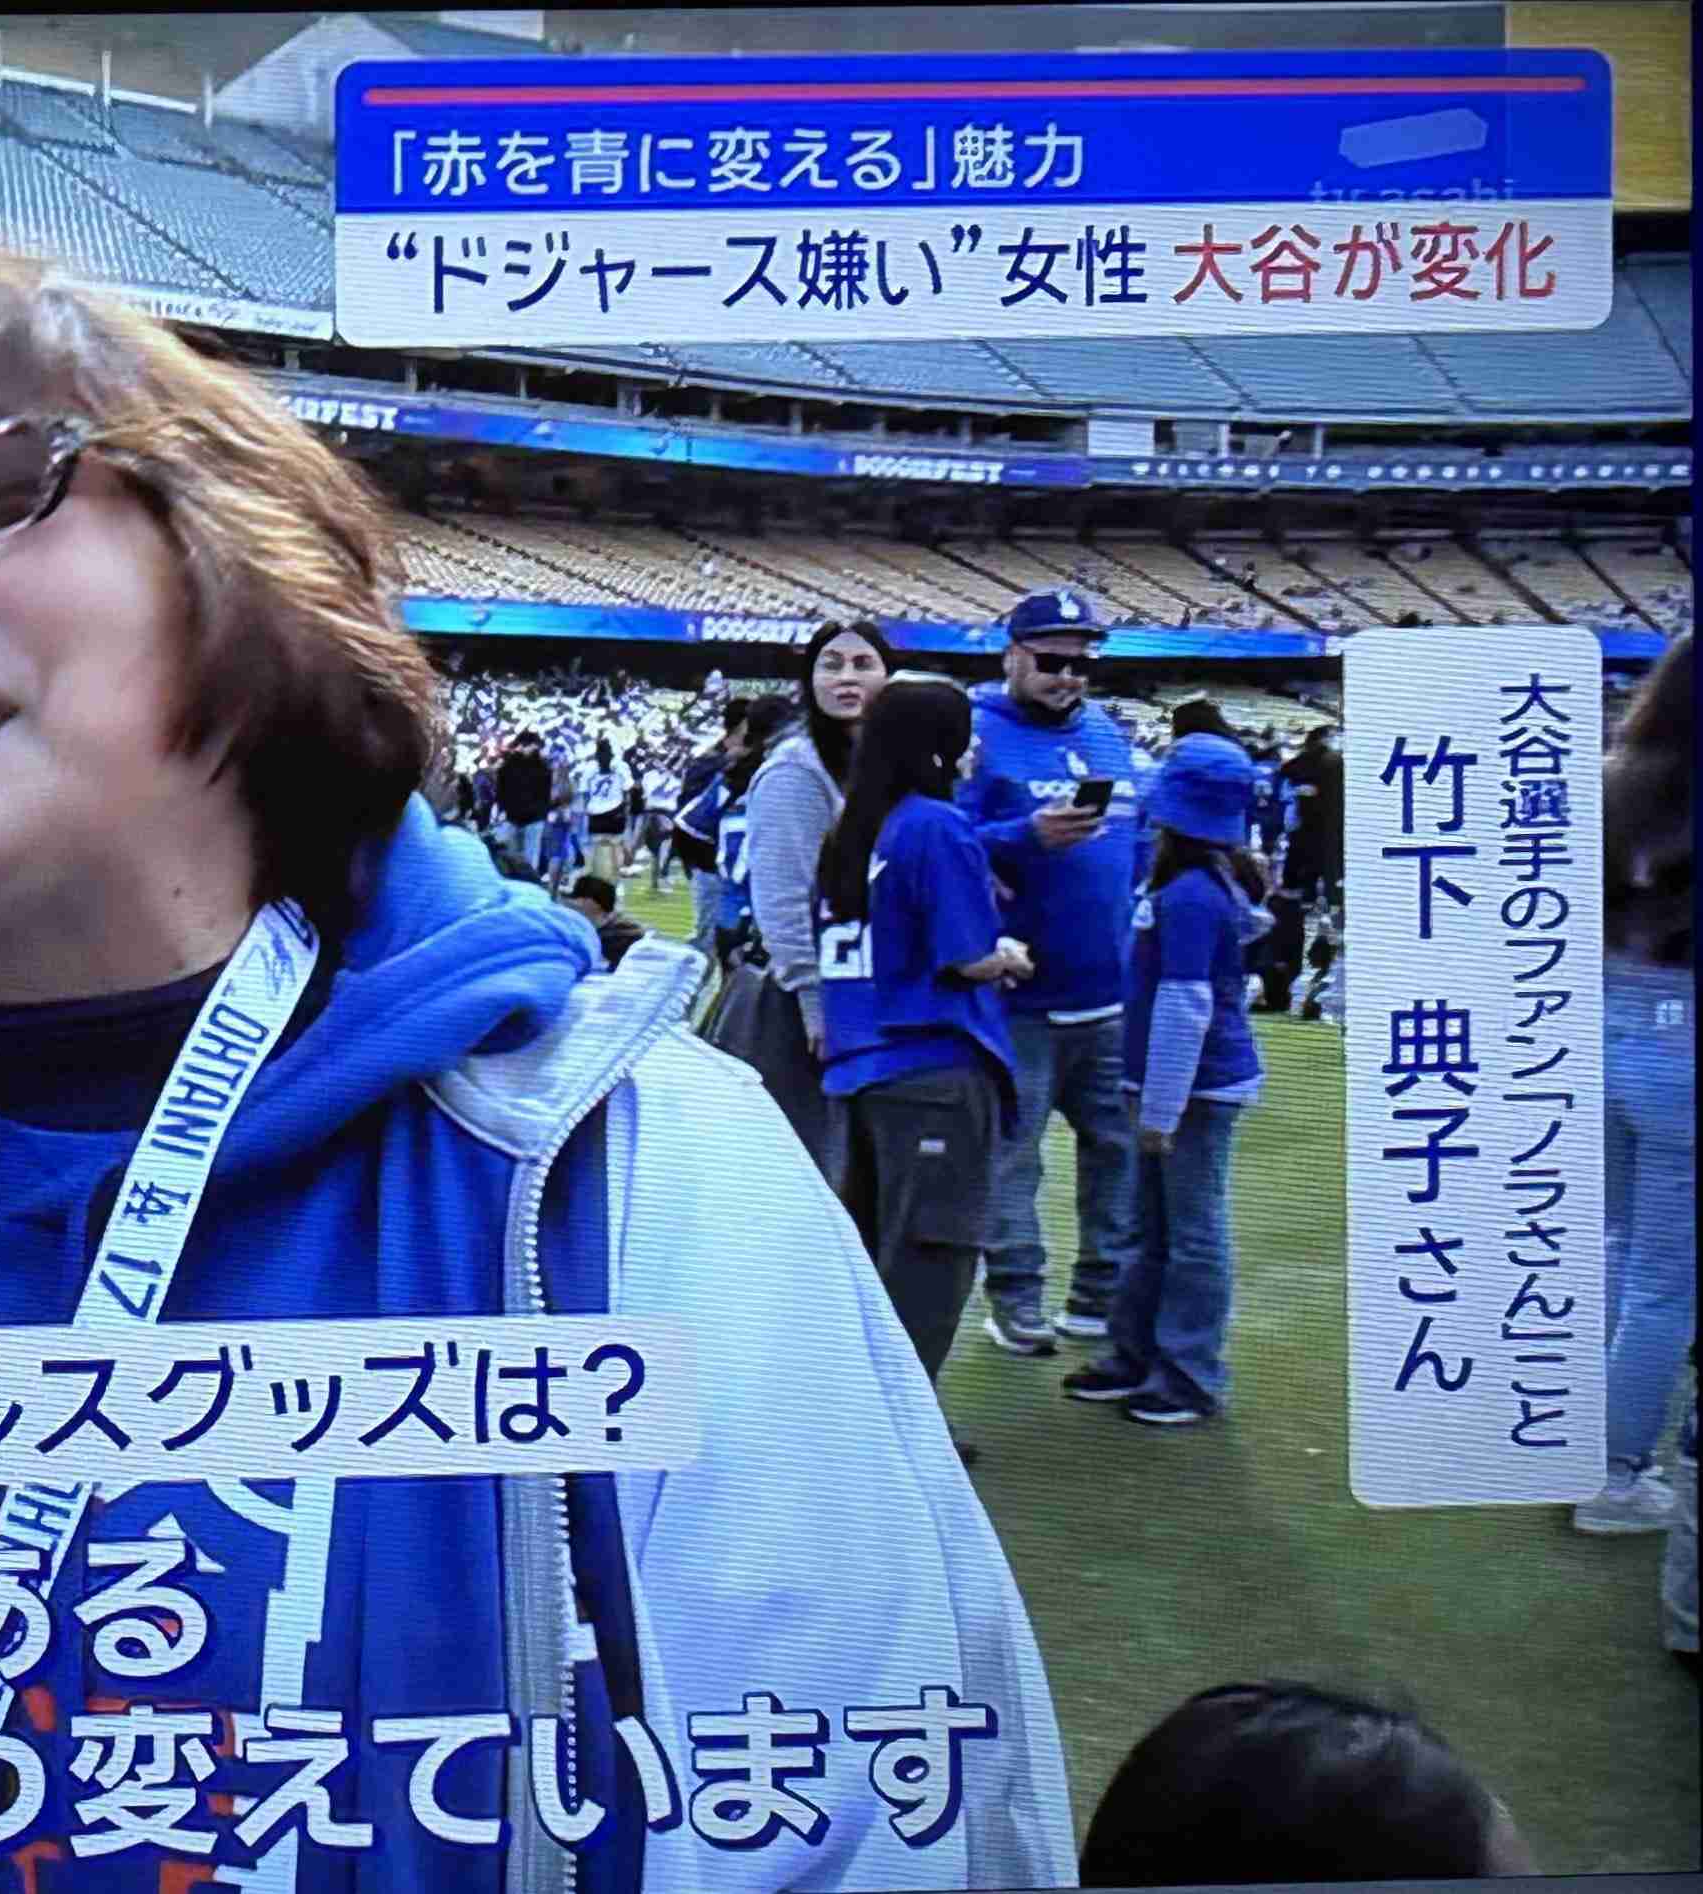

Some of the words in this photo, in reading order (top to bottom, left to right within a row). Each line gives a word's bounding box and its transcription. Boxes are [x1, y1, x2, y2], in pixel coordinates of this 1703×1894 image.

[391, 122, 1085, 197] 「赤を青に変える」魅力
[1173, 219, 1556, 306] 大谷が変化
[150, 1001, 269, 1161] OHTANI
[1498, 673, 1574, 1447] 大谷選手のファン「ノラさん」こと
